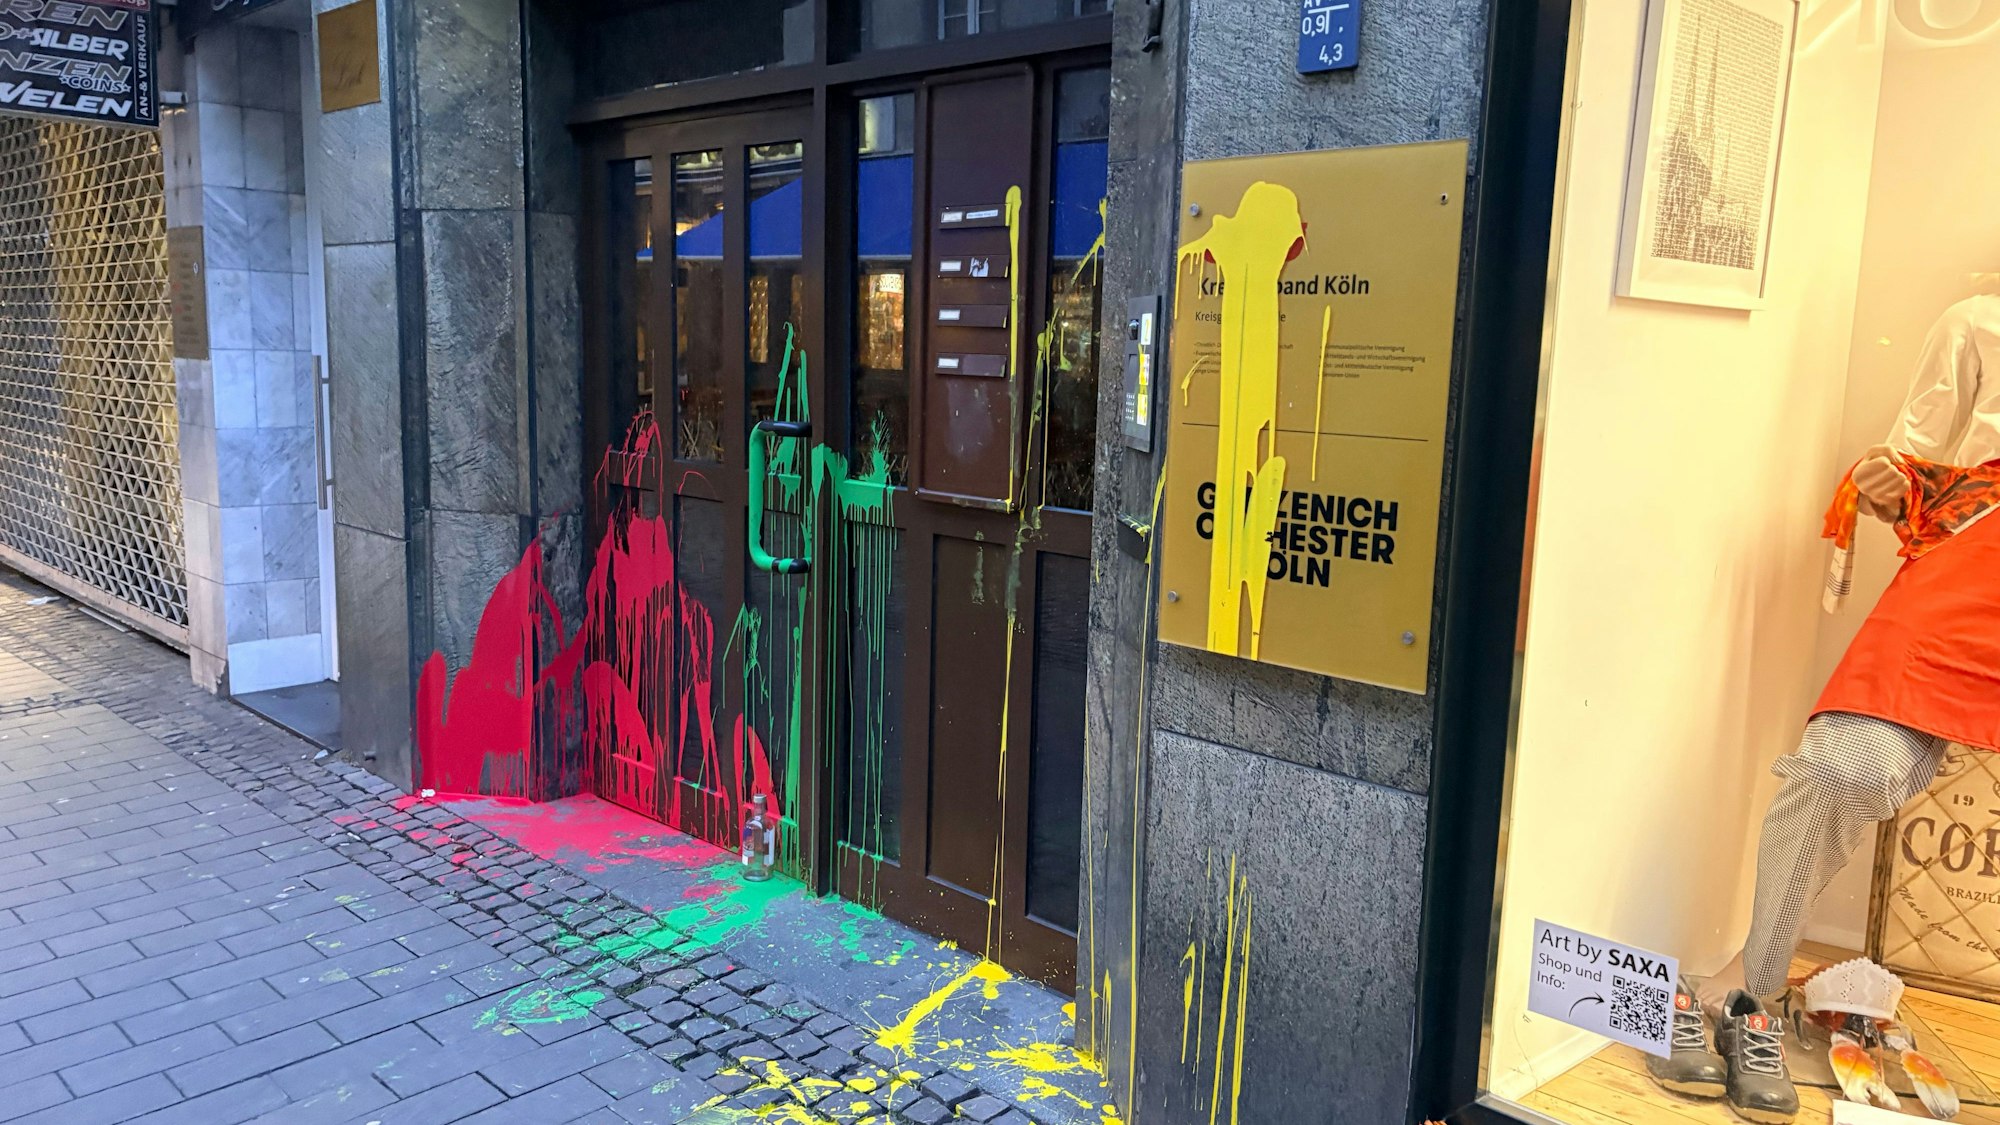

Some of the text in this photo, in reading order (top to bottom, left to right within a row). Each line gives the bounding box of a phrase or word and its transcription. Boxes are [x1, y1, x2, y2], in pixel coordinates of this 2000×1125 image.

[1302, 14, 1326, 37] 0,9
[137, 15, 148, 79] VERKAUF
[1319, 43, 1343, 66] 4,3
[67, 76, 124, 94] COINS
[1324, 274, 1370, 295] Köln
[1196, 512, 1395, 565] OHESTER
[1267, 551, 1330, 588] ÖLN
[1953, 794, 1975, 807] 19
[1540, 928, 1670, 982] Art by SAXA
[1966, 941, 1988, 953] the
[1538, 952, 1602, 982] Shop und
[1536, 971, 1566, 990] Info:
